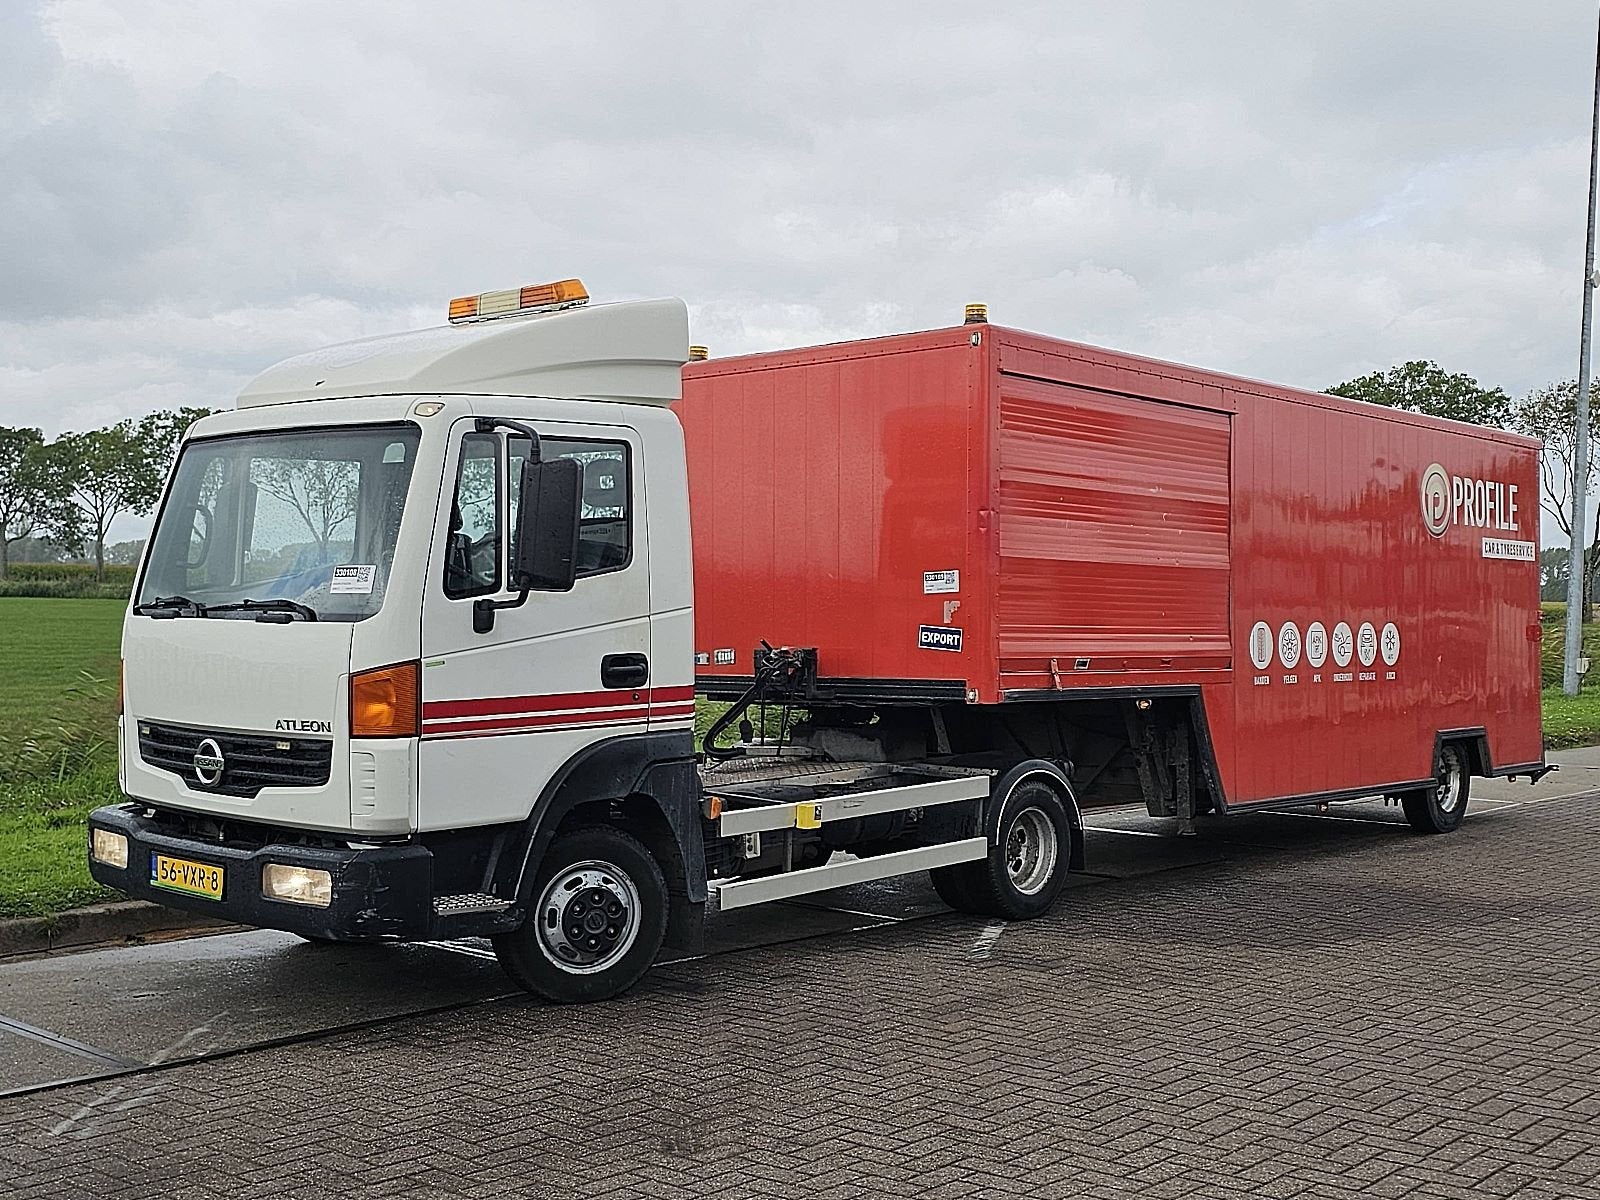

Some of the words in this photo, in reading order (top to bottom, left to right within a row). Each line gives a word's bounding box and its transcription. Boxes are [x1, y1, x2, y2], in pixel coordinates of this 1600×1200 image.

[1453, 476, 1518, 531] PROFILE
[922, 631, 960, 645] EXPORT
[275, 719, 332, 733] ATLEON
[161, 860, 219, 891] 56-VXR-8
